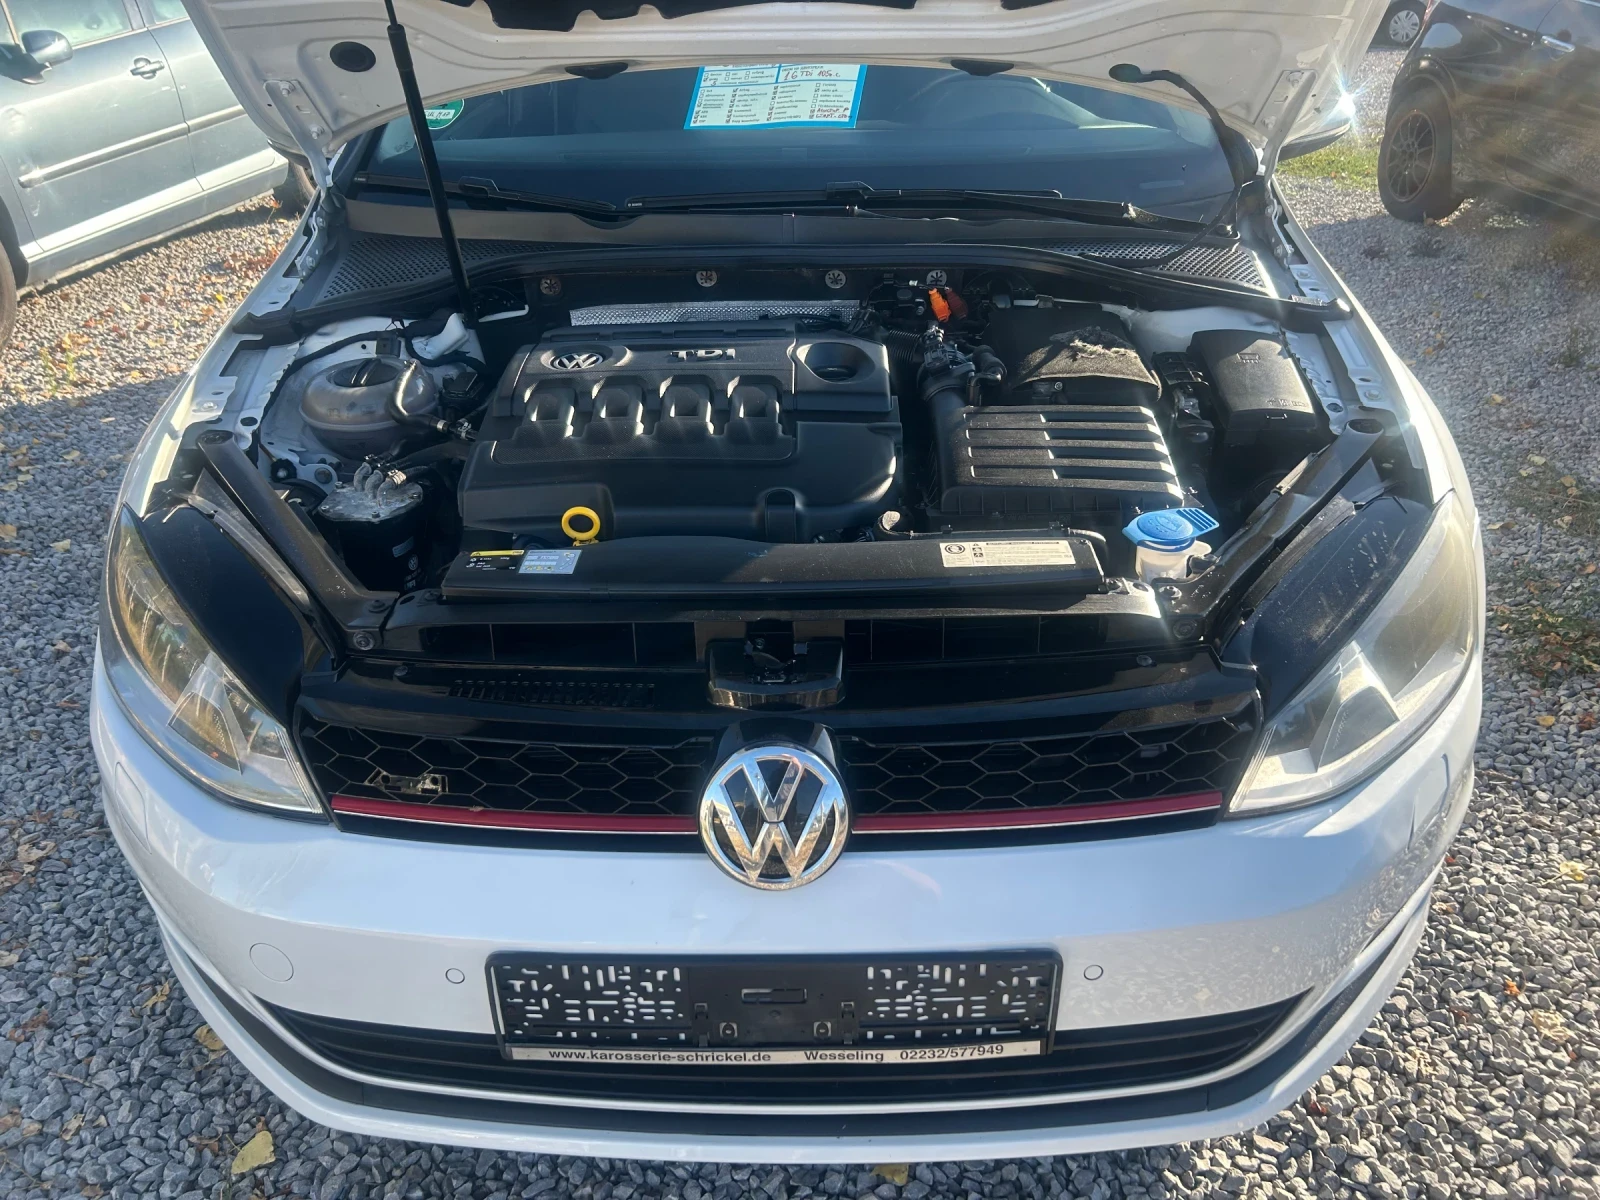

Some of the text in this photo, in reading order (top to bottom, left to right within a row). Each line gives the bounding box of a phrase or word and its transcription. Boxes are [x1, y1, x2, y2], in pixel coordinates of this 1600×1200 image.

[671, 348, 736, 361] TDI
[549, 1044, 1005, 1063] www.karosserie-schrickel.de Wesseling 02232/577949
